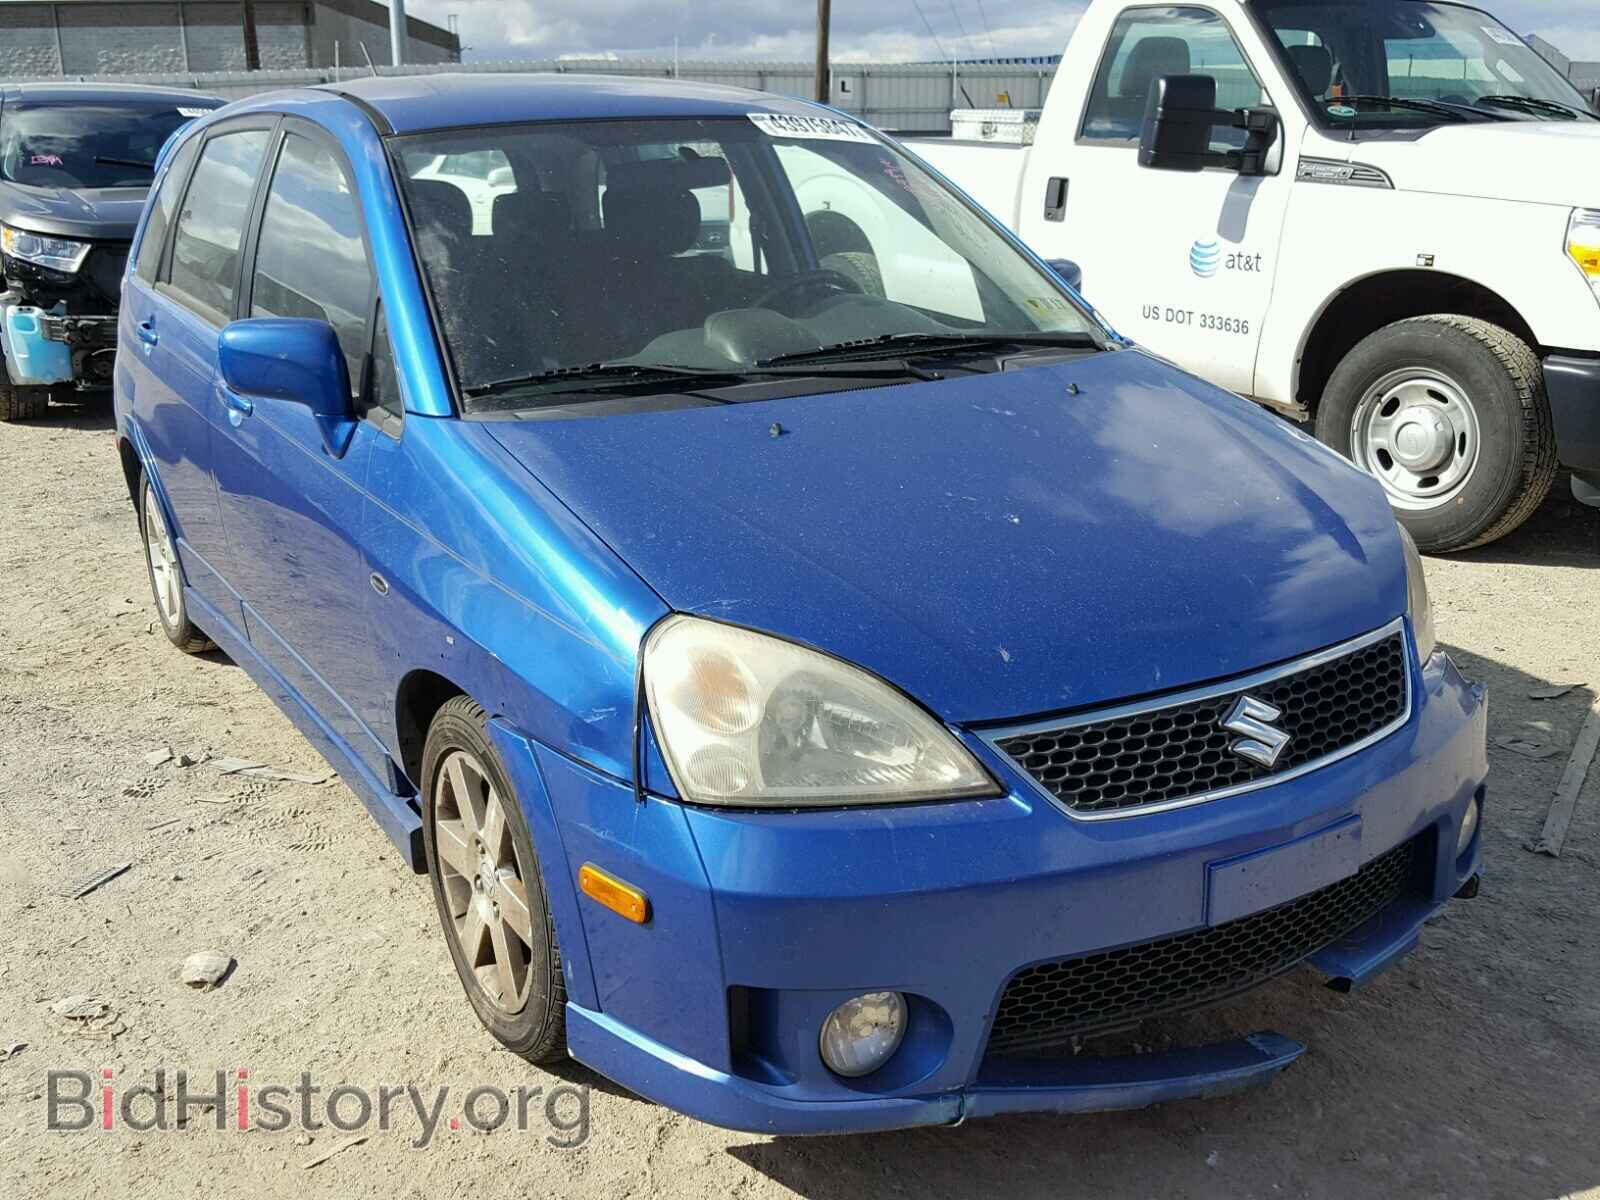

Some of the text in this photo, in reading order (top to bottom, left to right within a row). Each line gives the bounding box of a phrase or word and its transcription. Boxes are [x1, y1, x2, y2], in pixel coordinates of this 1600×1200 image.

[1225, 251, 1261, 272] at&t
[1142, 304, 1249, 335] US DOT 333636
